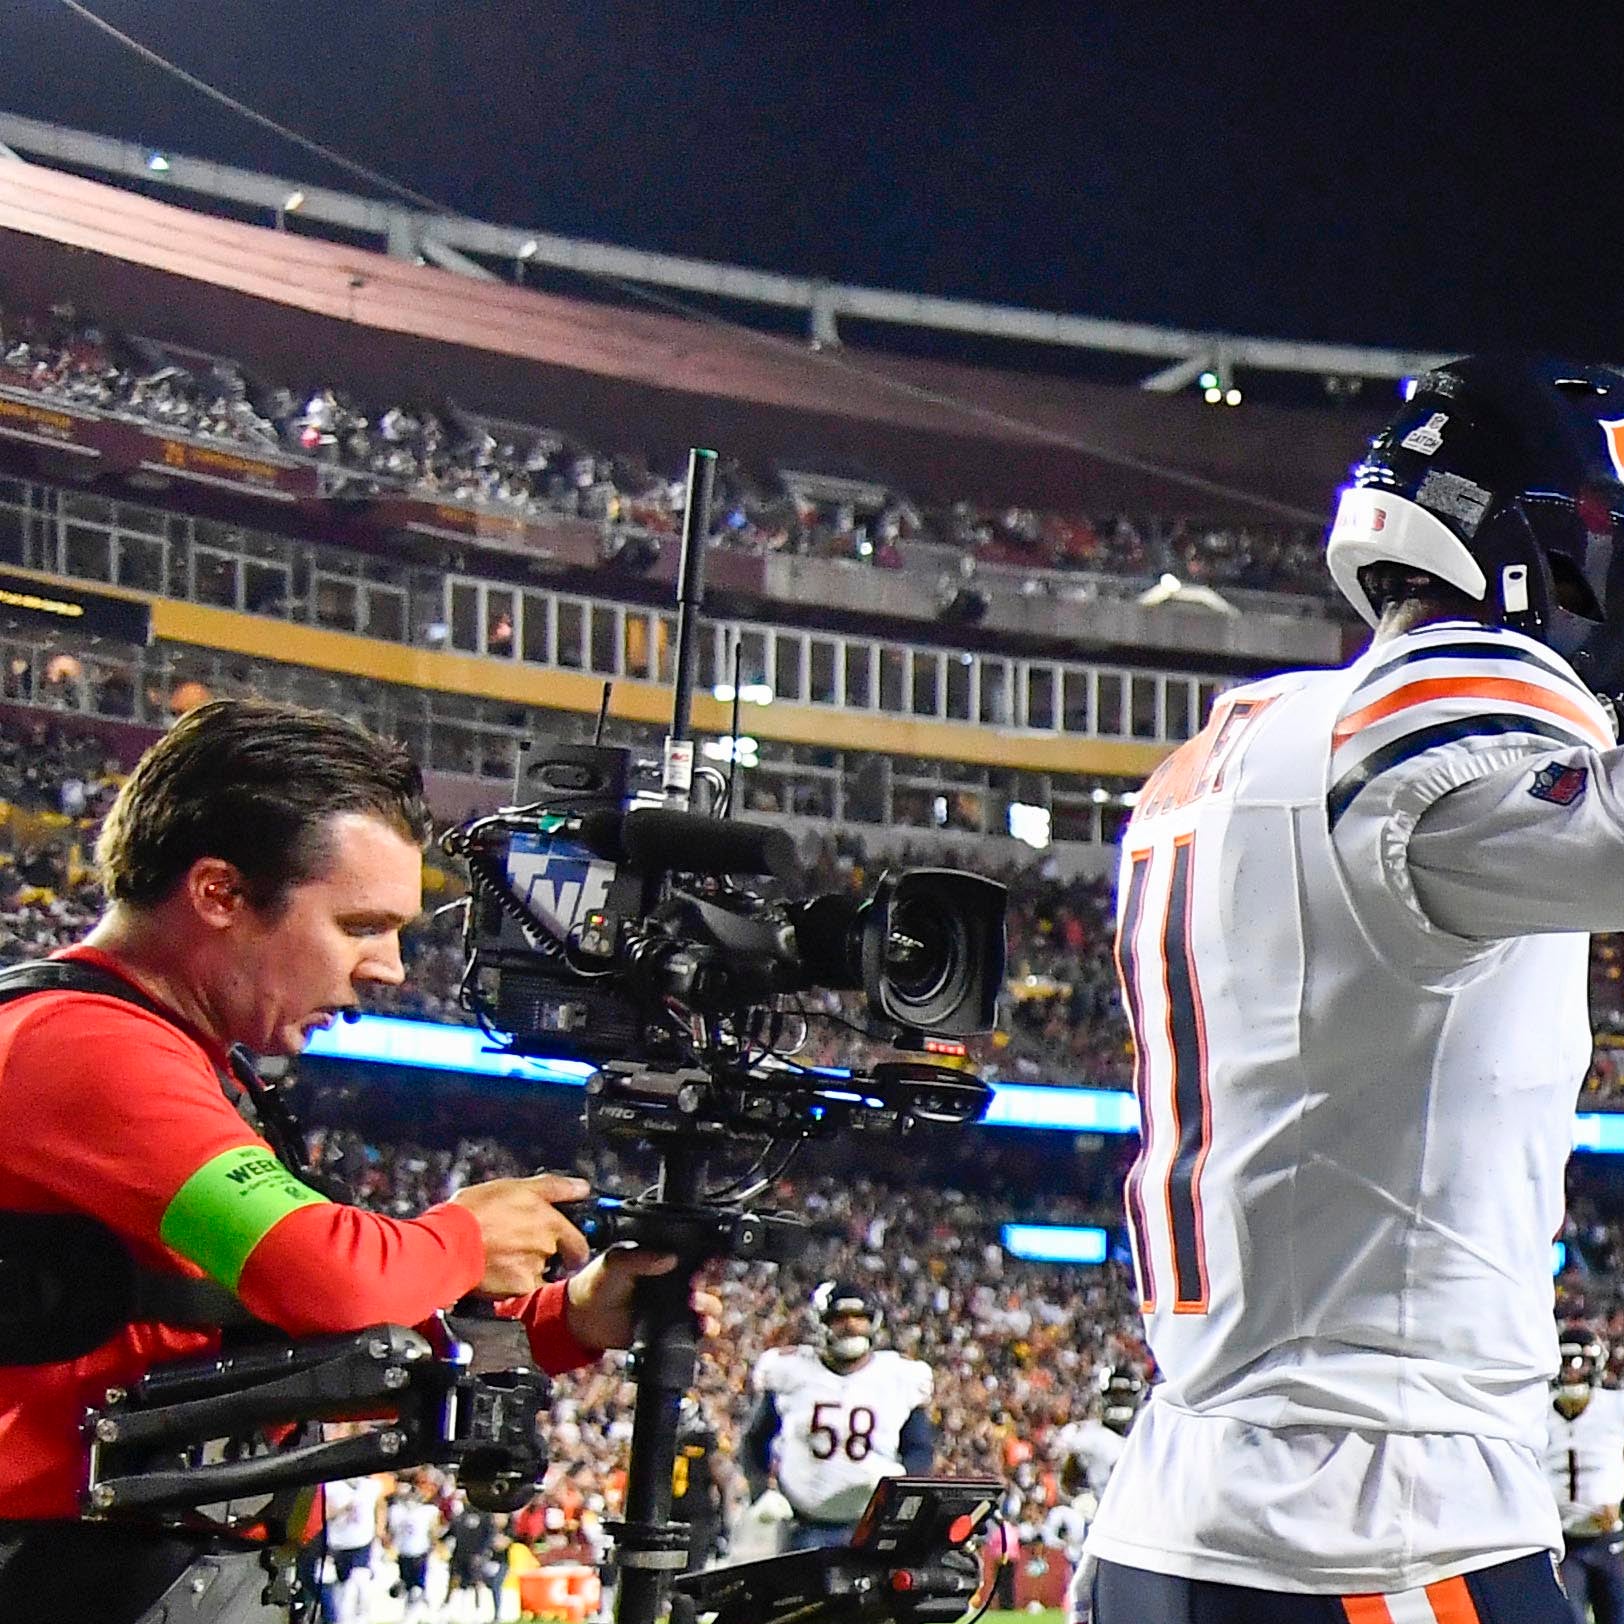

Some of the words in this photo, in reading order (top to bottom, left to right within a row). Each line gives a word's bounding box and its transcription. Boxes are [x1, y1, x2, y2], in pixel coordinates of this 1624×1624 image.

[1406, 431, 1440, 448] CATCH
[1114, 829, 1215, 1315] 11
[809, 1401, 877, 1461] 58
